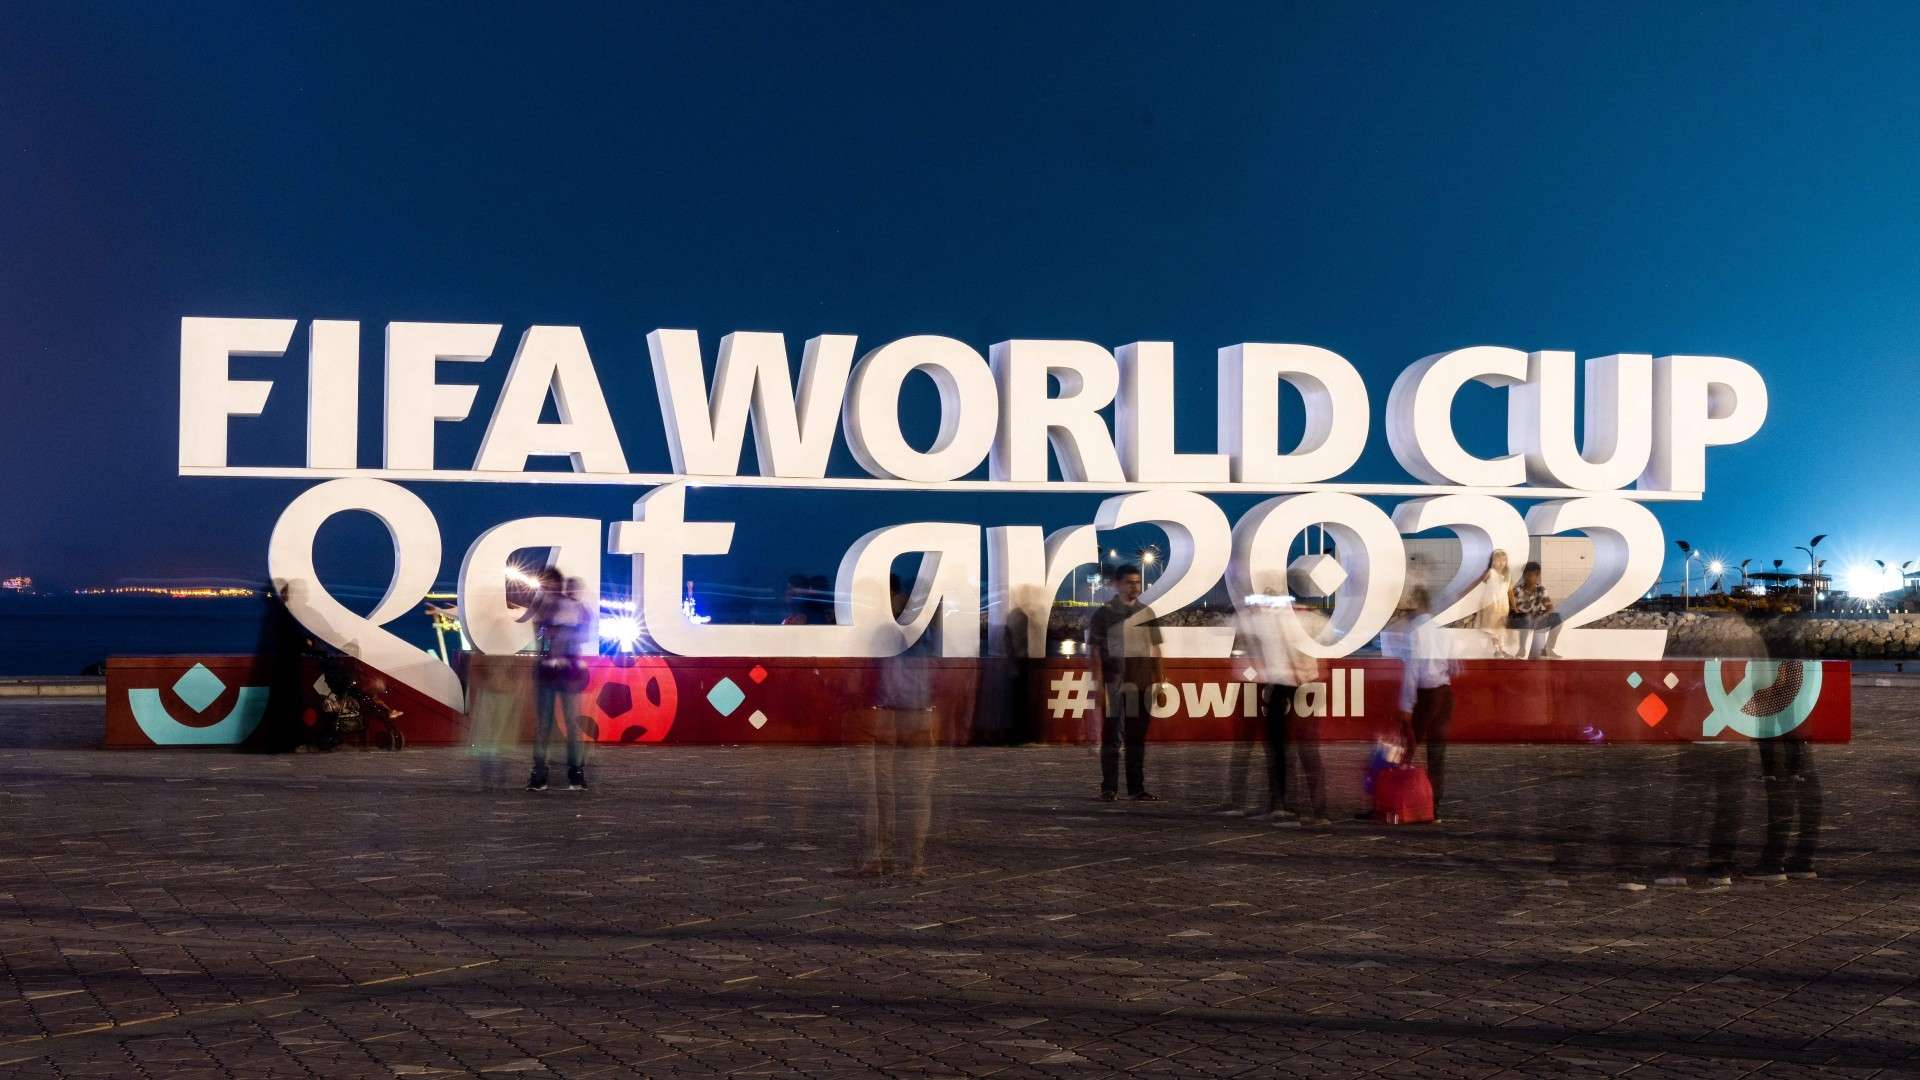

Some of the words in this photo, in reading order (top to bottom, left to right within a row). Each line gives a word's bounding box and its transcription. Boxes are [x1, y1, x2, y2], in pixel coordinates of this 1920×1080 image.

[180, 316, 629, 473] FIFA
[646, 328, 1370, 484] WORLD
[1386, 345, 1768, 493] CUP
[267, 478, 1099, 712] Qatar
[1095, 490, 1668, 660] 2022
